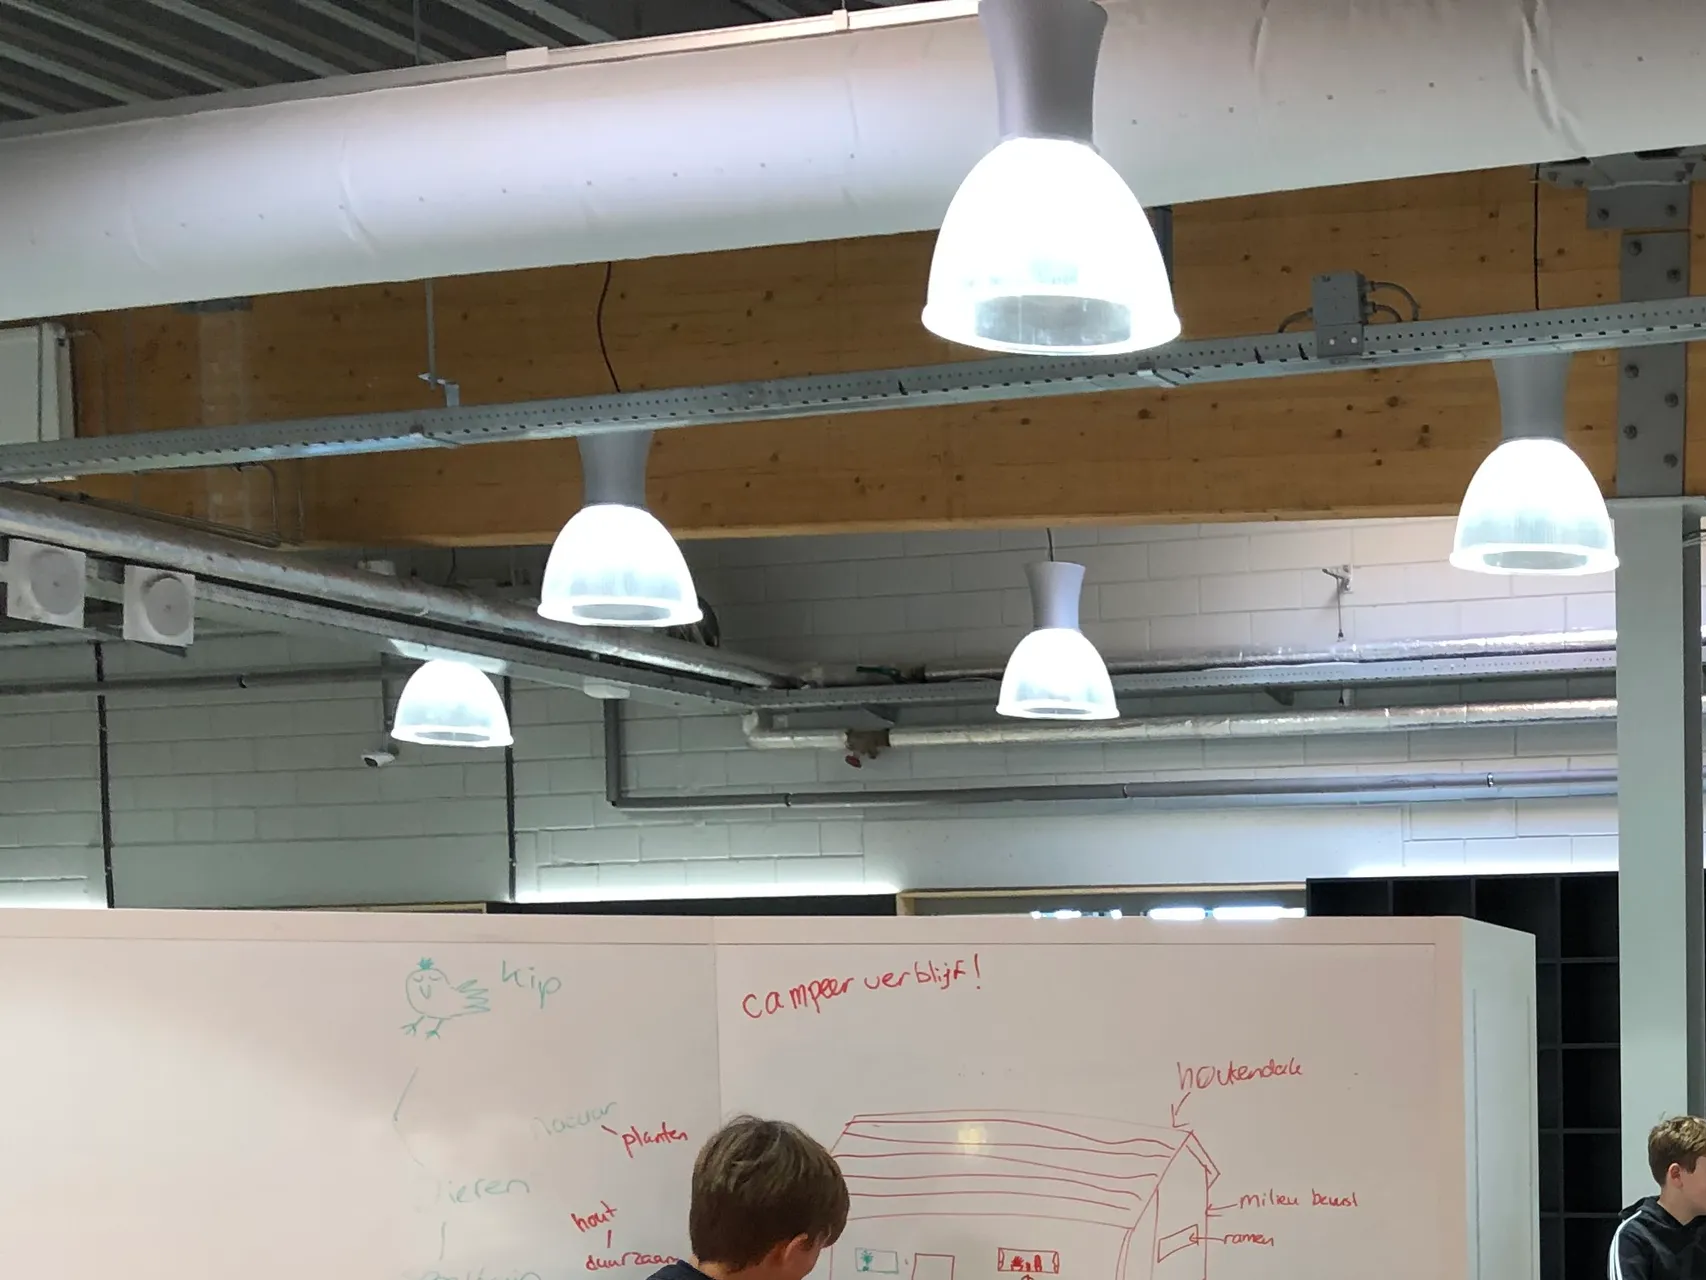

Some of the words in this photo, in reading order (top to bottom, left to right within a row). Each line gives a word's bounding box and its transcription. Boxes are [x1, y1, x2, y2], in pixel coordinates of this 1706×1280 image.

[621, 1120, 690, 1159] planten
[1239, 1187, 1300, 1210] milieu
[570, 1200, 618, 1233] hout
